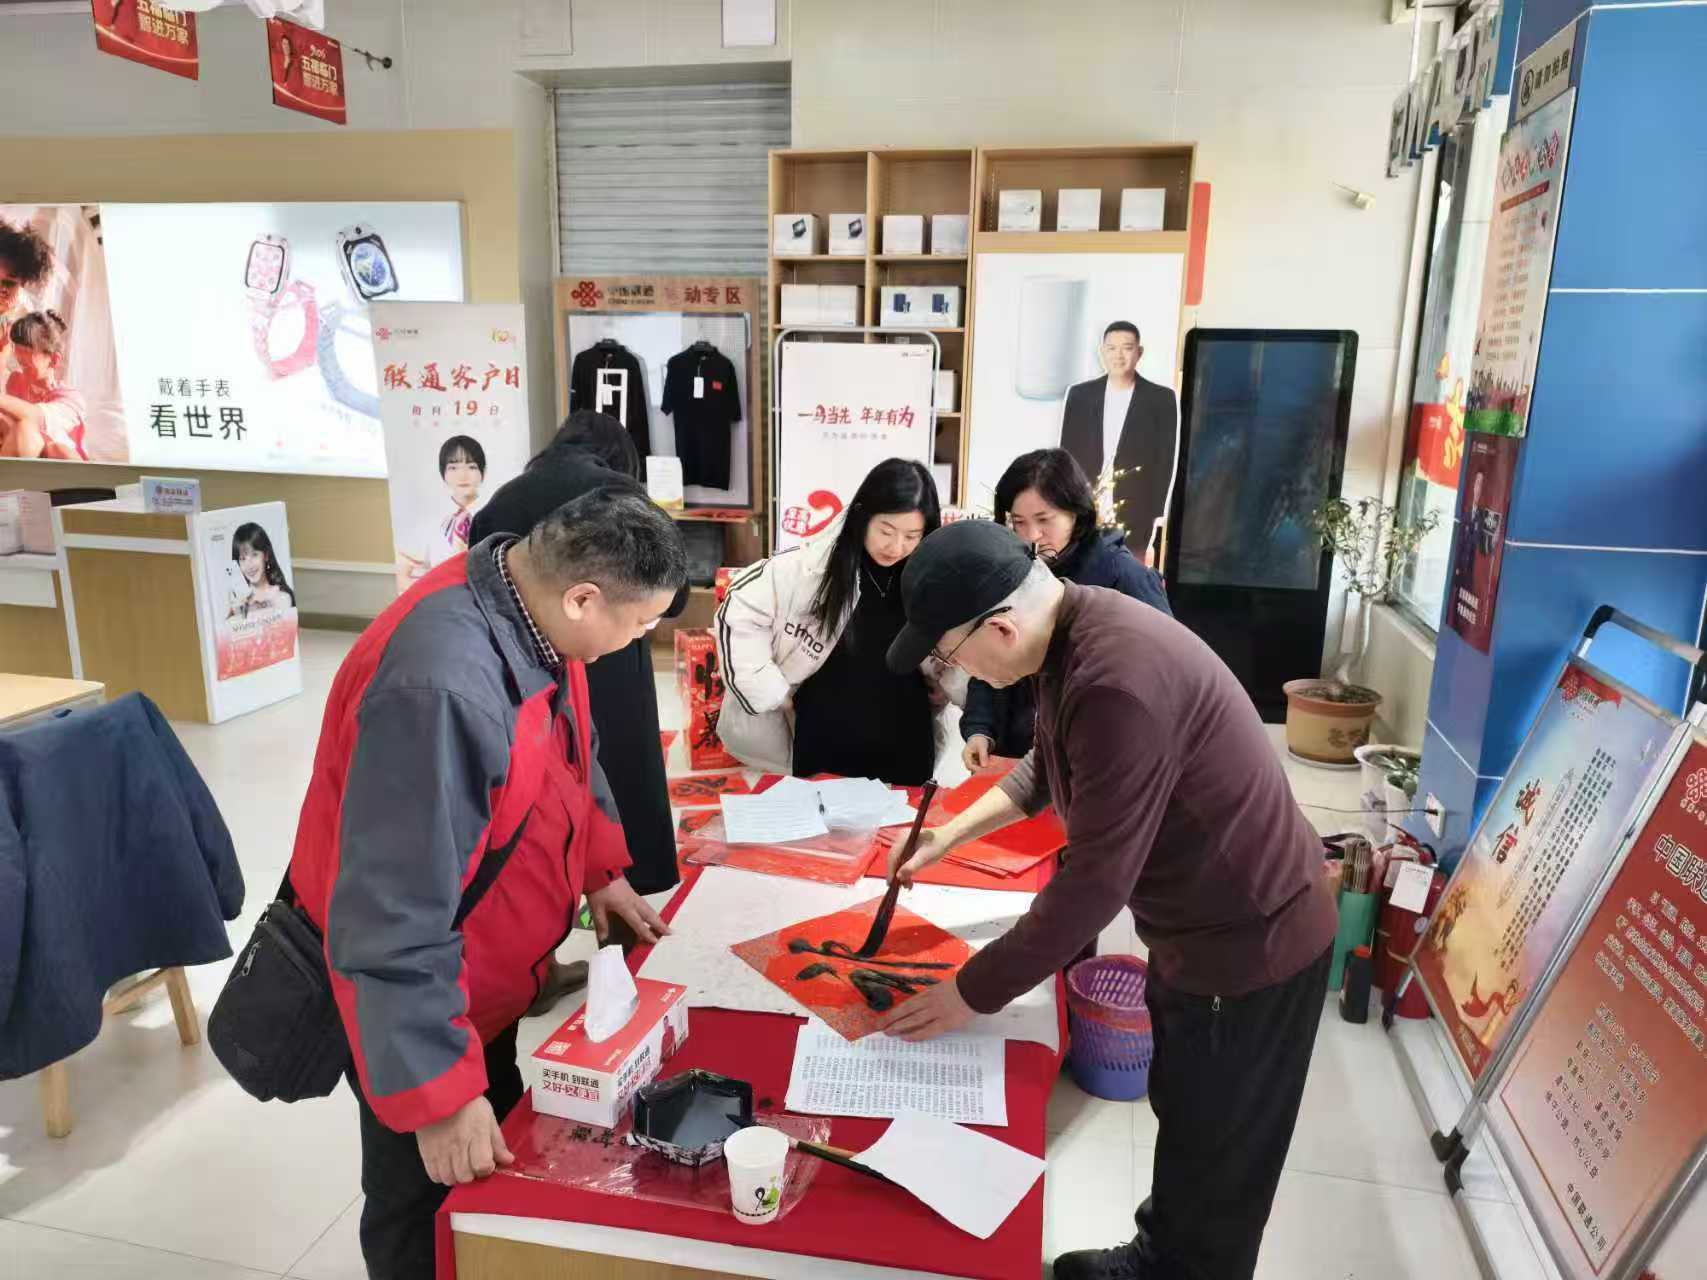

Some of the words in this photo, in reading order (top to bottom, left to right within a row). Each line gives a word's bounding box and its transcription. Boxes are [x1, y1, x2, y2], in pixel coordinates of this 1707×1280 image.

[158, 377, 232, 398] 戴着手表
[383, 361, 520, 392] 联通客户日
[150, 404, 247, 440] 看世界
[798, 404, 852, 424] 一马当先
[860, 405, 915, 428] 年年有为
[543, 1068, 569, 1083] 买手机
[572, 1072, 599, 1089] 到联通
